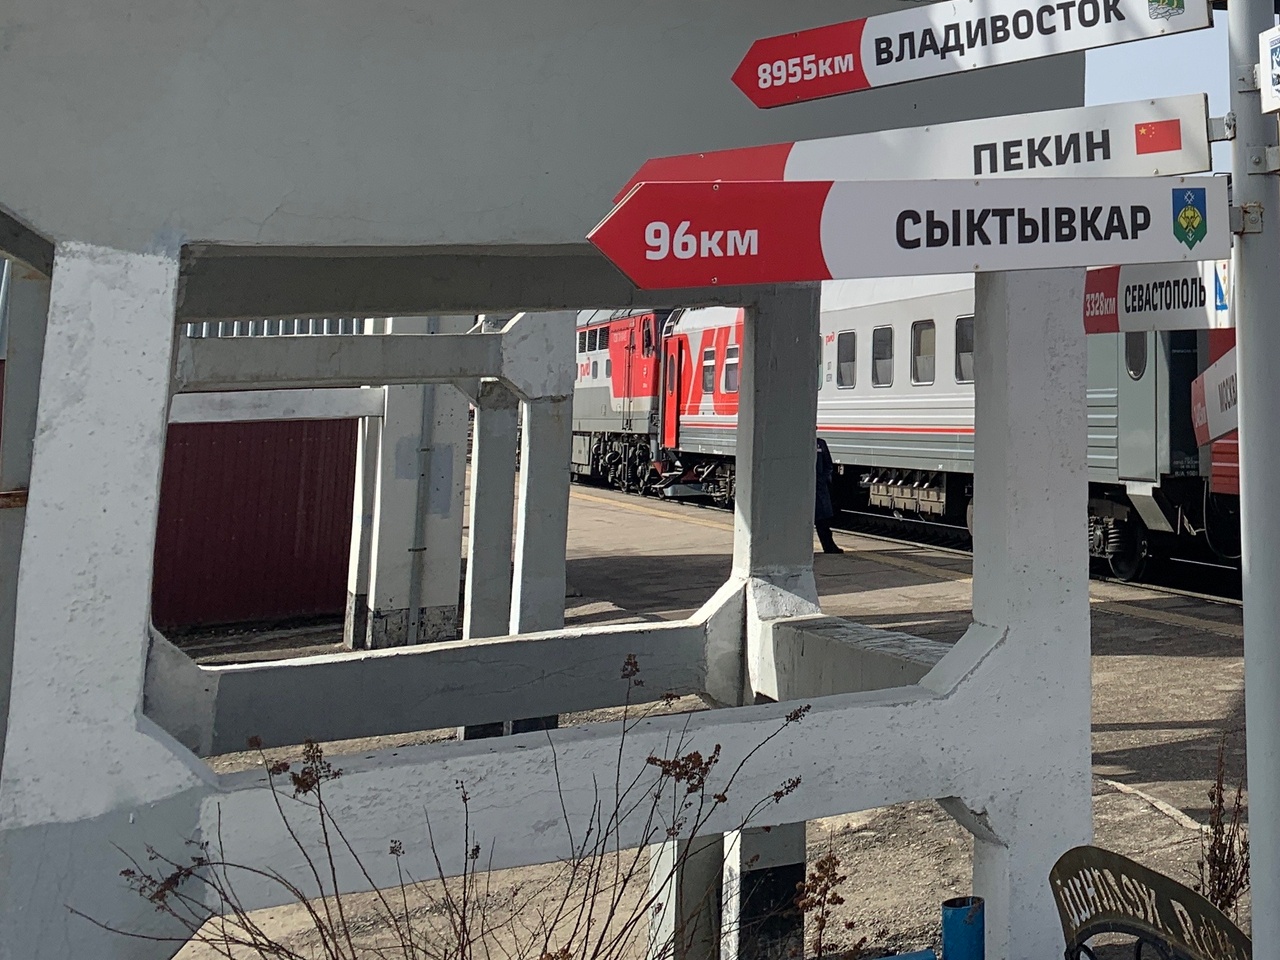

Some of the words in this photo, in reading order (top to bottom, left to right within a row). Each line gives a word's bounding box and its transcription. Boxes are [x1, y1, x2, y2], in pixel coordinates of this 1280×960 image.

[757, 52, 853, 88] 8955км
[974, 129, 1111, 175] ПЕКИН
[644, 221, 758, 260] 96км
[895, 205, 1151, 249] СЫКТЫВКАР
[1085, 292, 1116, 317] 3328км
[1125, 277, 1206, 313] СЕВАСТОПОЛЬ
